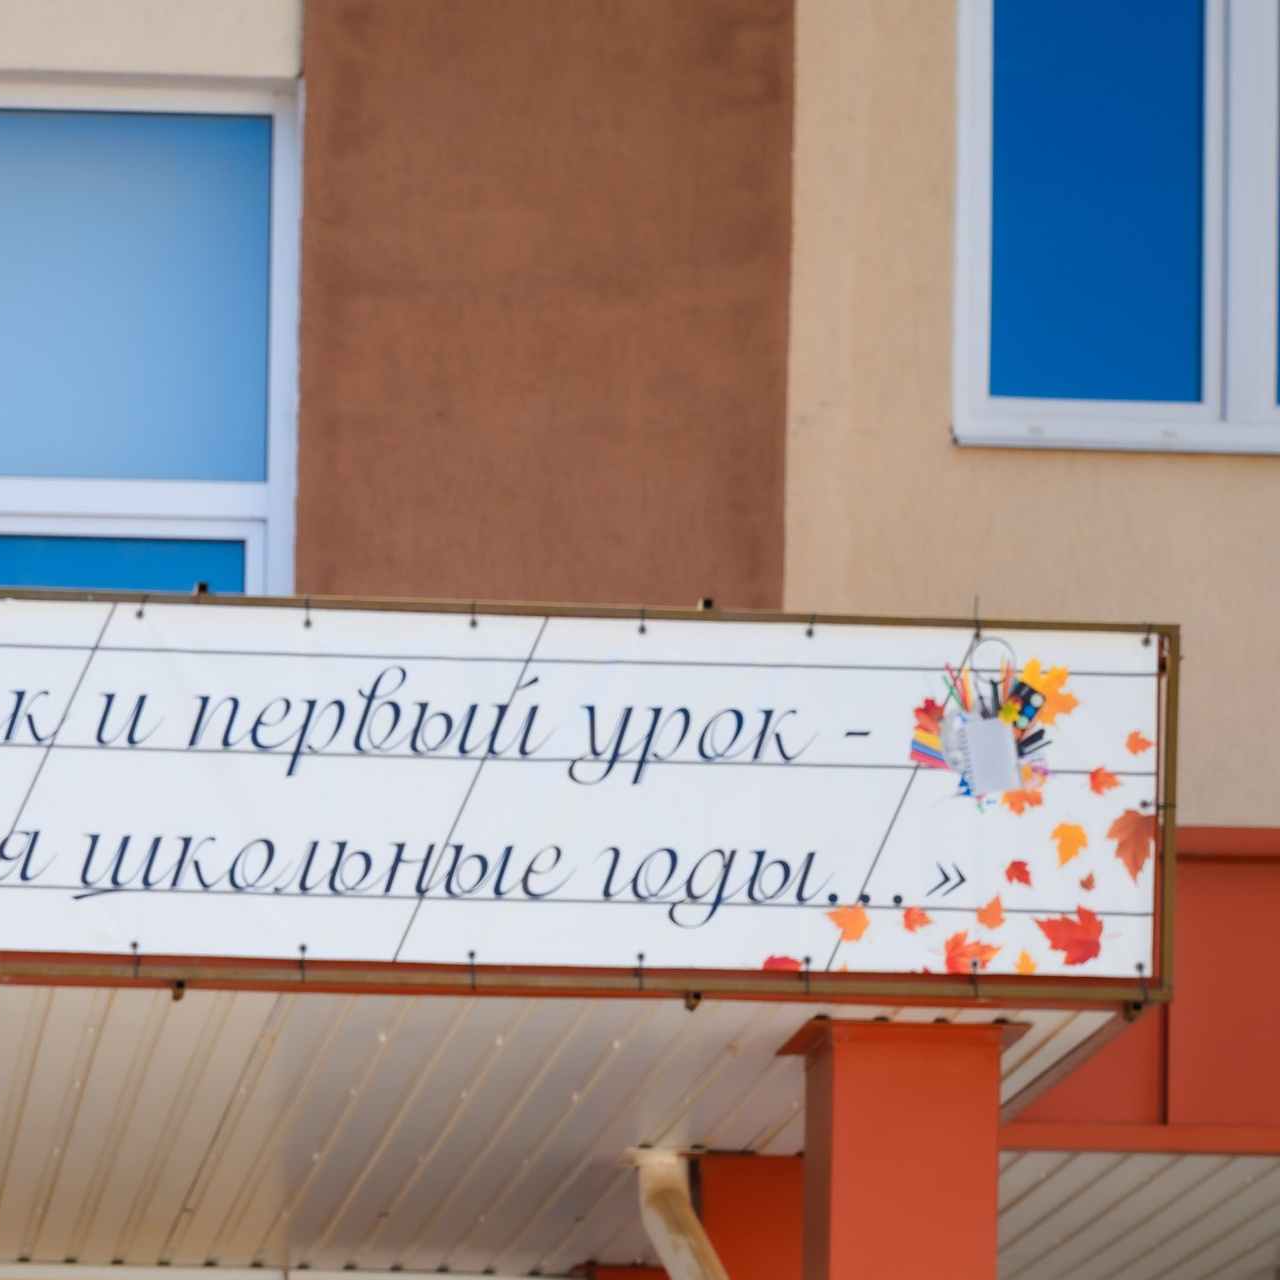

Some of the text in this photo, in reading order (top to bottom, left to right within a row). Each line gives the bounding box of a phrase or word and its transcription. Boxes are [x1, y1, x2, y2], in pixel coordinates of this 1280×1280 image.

[95, 689, 167, 747] и
[186, 665, 556, 777] первый
[568, 703, 818, 785] урок
[73, 831, 575, 900] школьные
